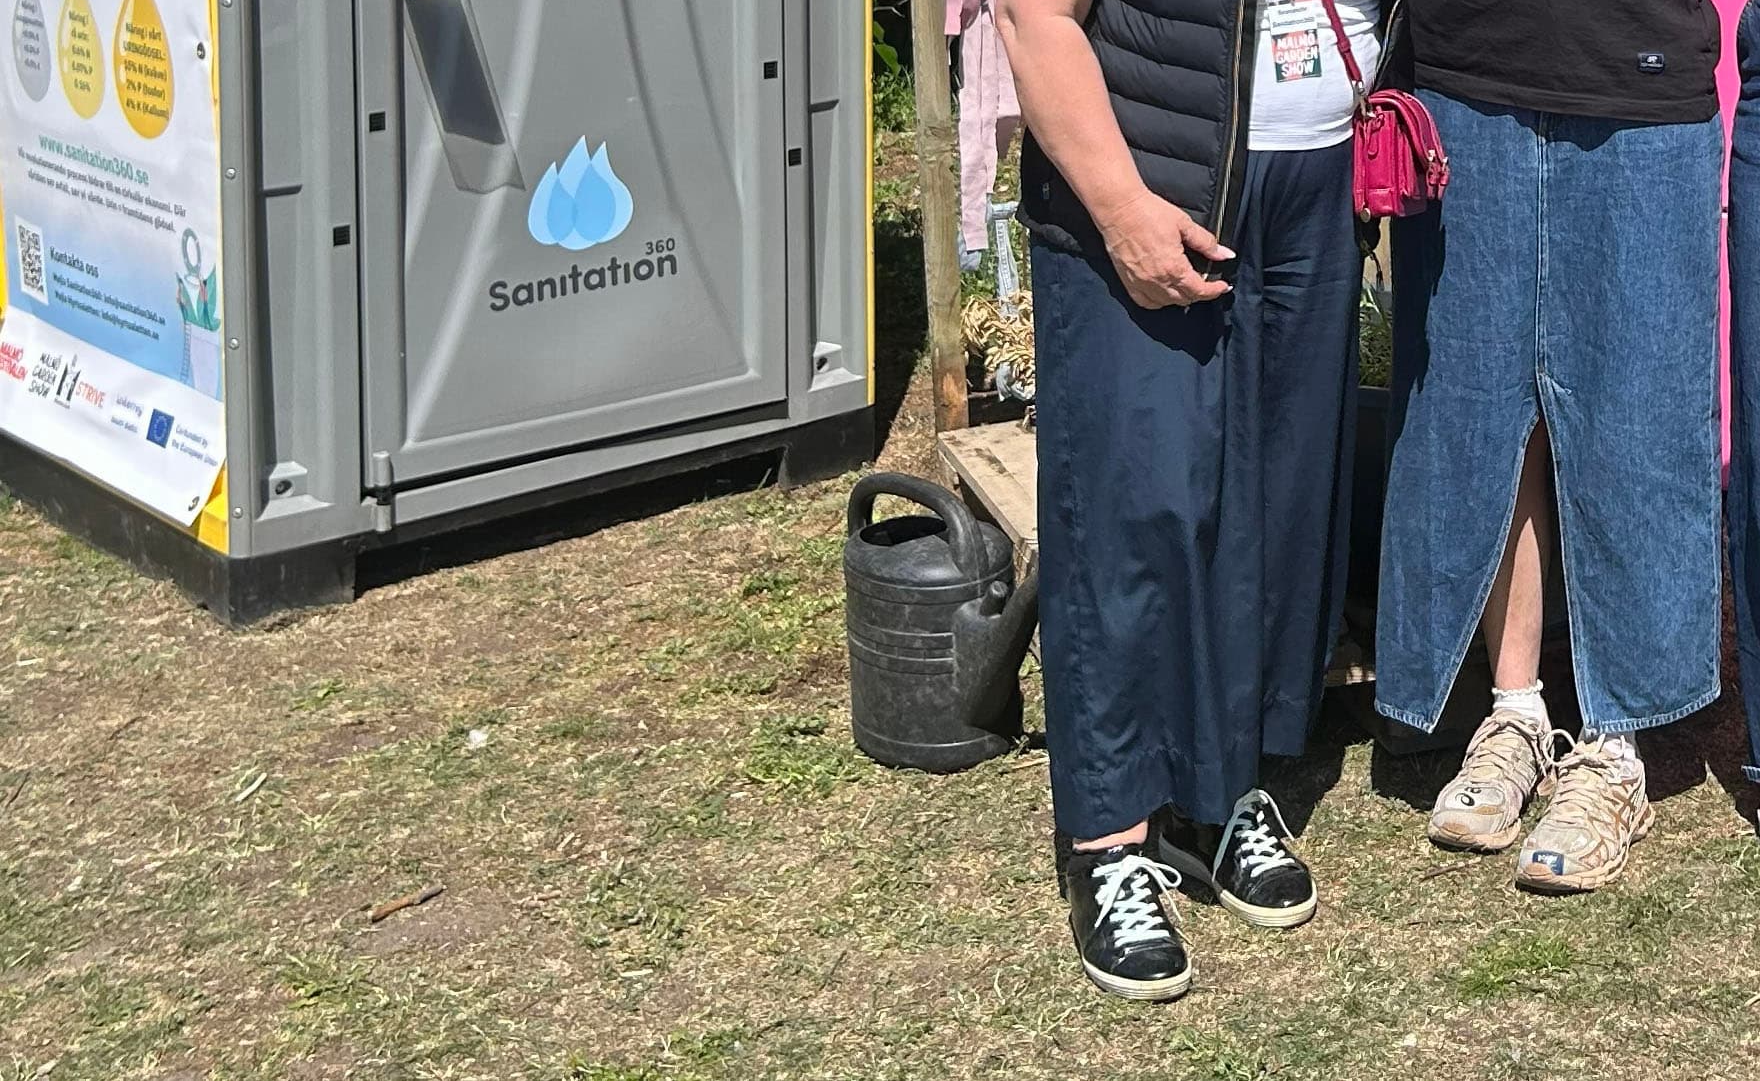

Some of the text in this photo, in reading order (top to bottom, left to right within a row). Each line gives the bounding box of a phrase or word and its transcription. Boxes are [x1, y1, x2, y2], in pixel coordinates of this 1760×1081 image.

[1275, 46, 1318, 64] GARDEN
[1281, 60, 1314, 77] SHOW
[38, 134, 149, 186] www.sanitation360.se
[645, 238, 676, 256] 360
[489, 254, 678, 312] Sanitation
[76, 381, 106, 409] STRIVE
